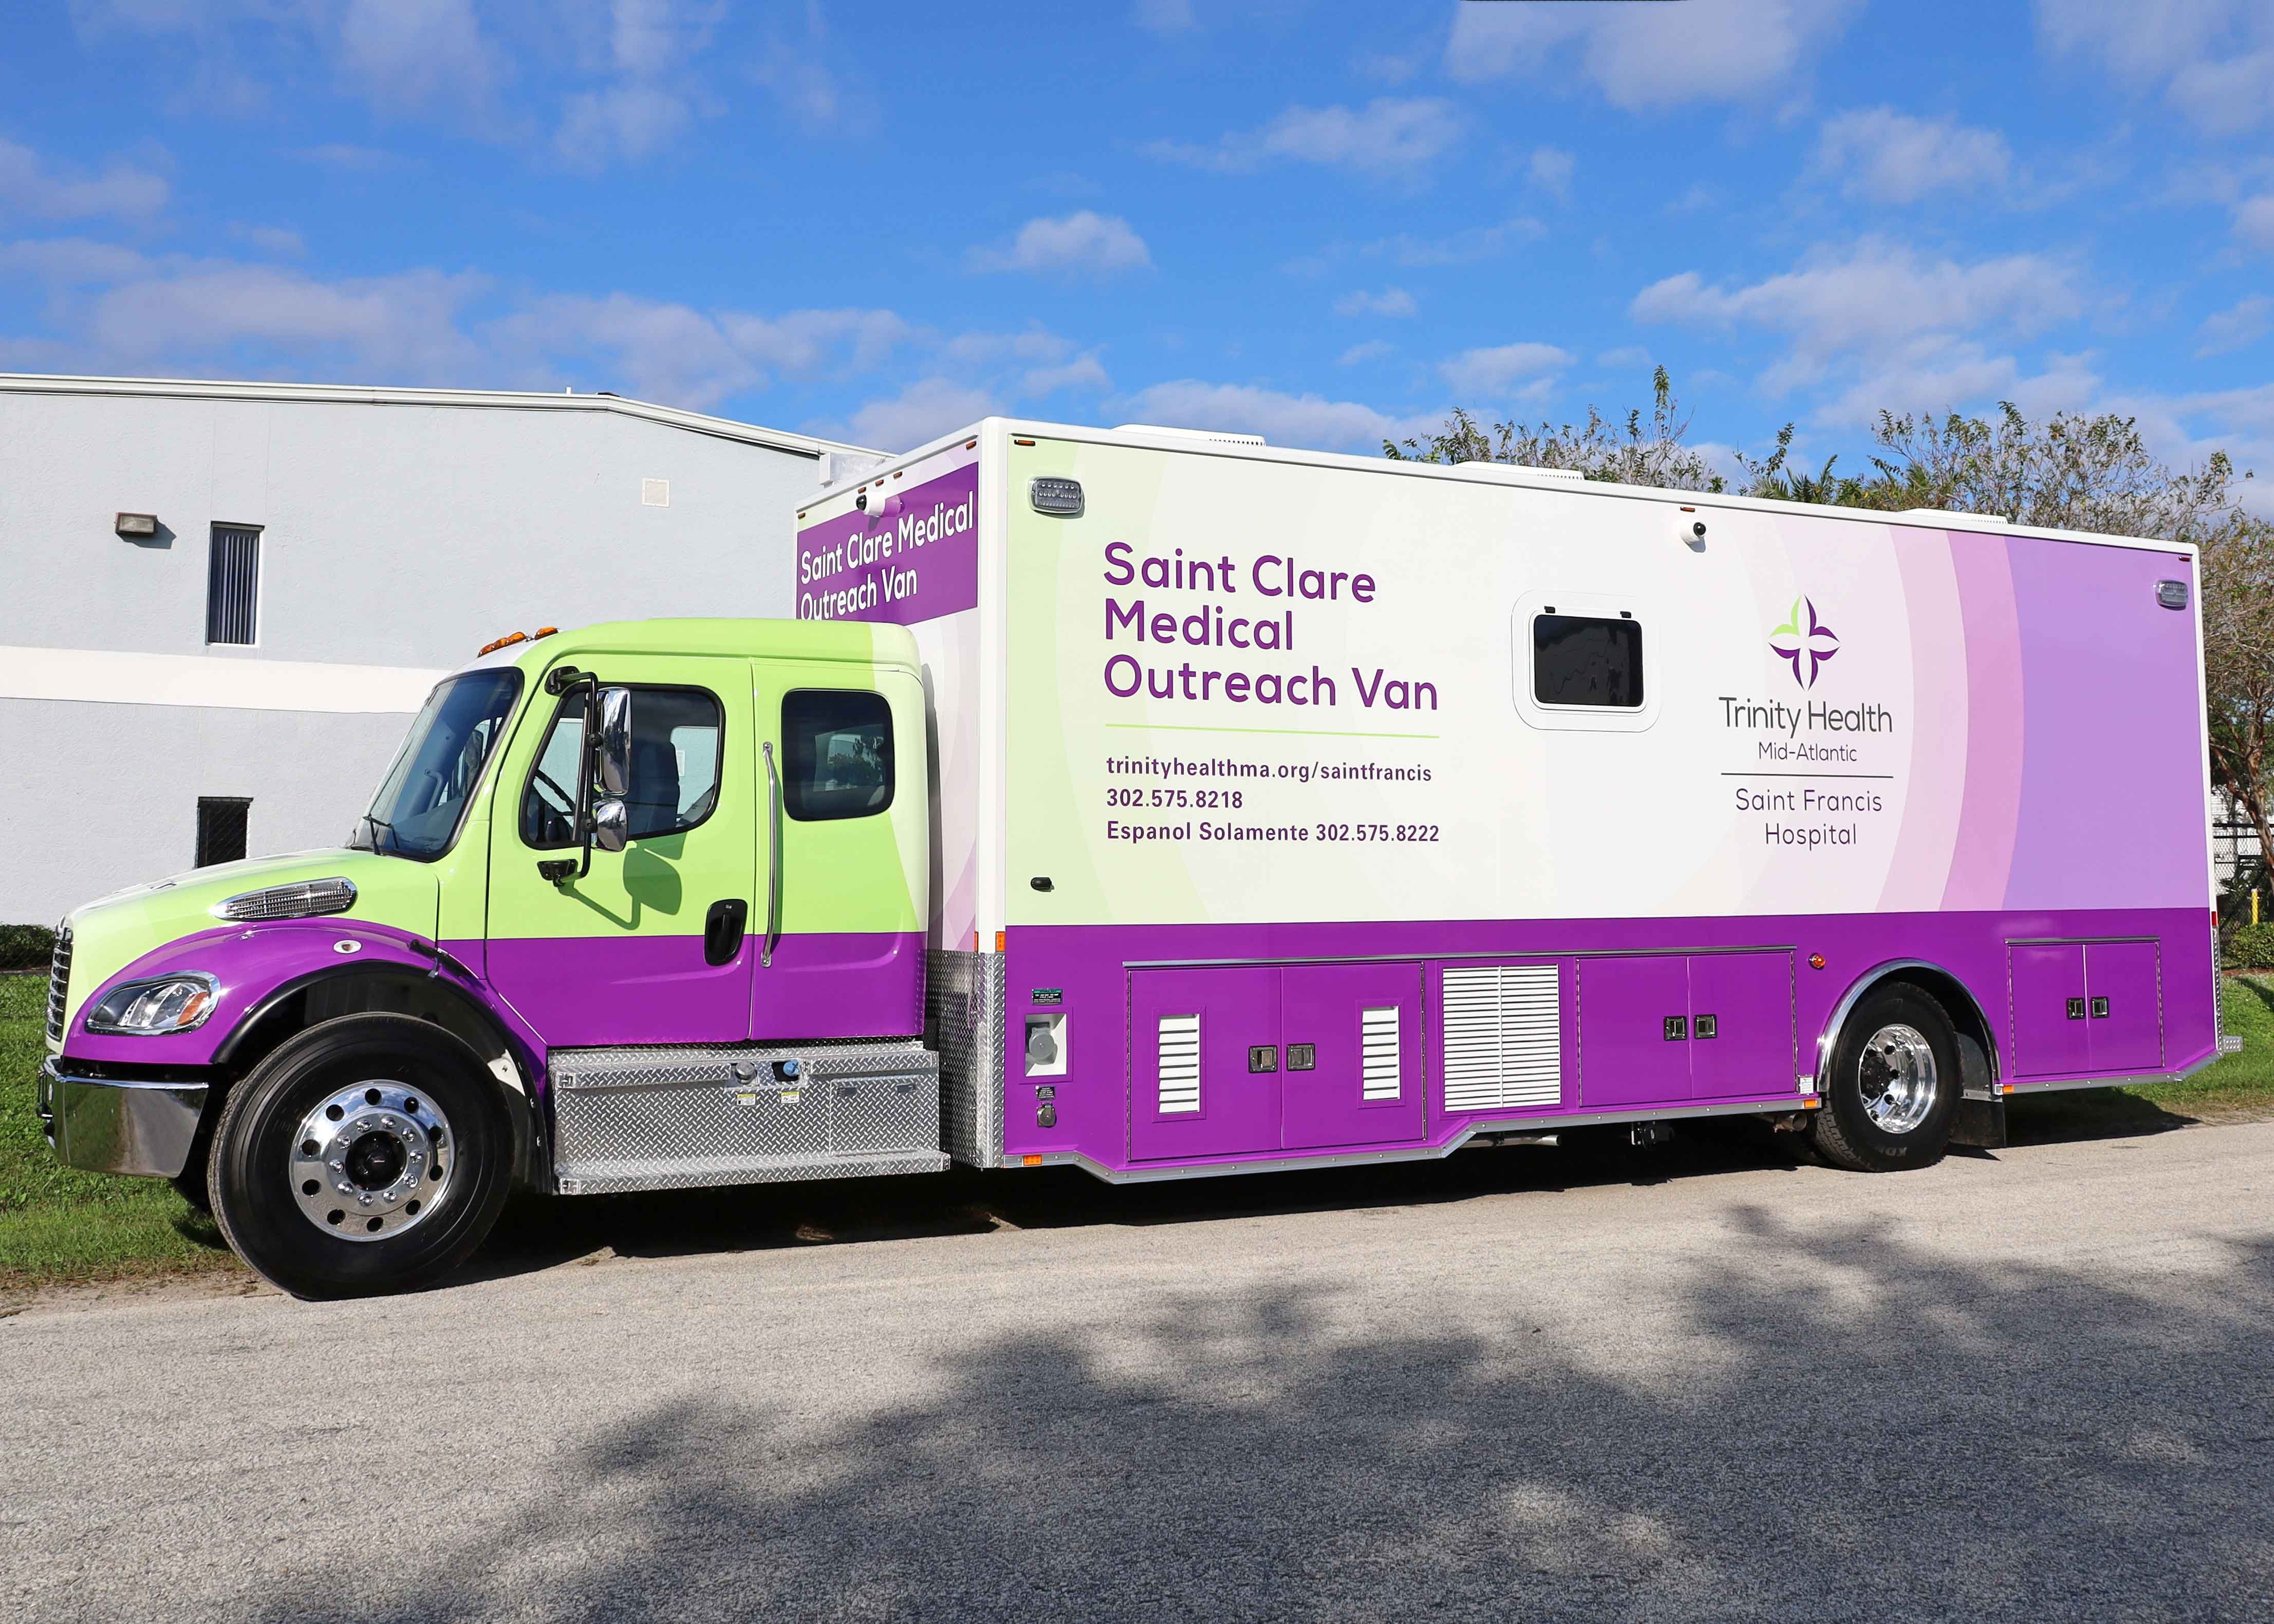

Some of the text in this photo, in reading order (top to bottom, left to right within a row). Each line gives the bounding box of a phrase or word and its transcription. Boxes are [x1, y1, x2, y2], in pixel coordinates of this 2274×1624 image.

[800, 491, 974, 585] Saint Clare Medical
[1104, 542, 1376, 603] Saint Clare
[800, 565, 918, 621] Outreach Van
[1105, 598, 1293, 650] Medical
[1104, 654, 1438, 711] Outreach Van
[1718, 697, 1893, 739] Trinity Health
[1106, 755, 1432, 783] trinityhealthma.org/saintfrancis
[1758, 741, 1858, 762] Mid-Atlantic
[1106, 788, 1243, 809] 302.575.8218
[1736, 788, 1882, 812] Saint Francis
[1107, 820, 1440, 845] Espanol Solamente 302.575.8222
[1765, 823, 1857, 852] Hospital
